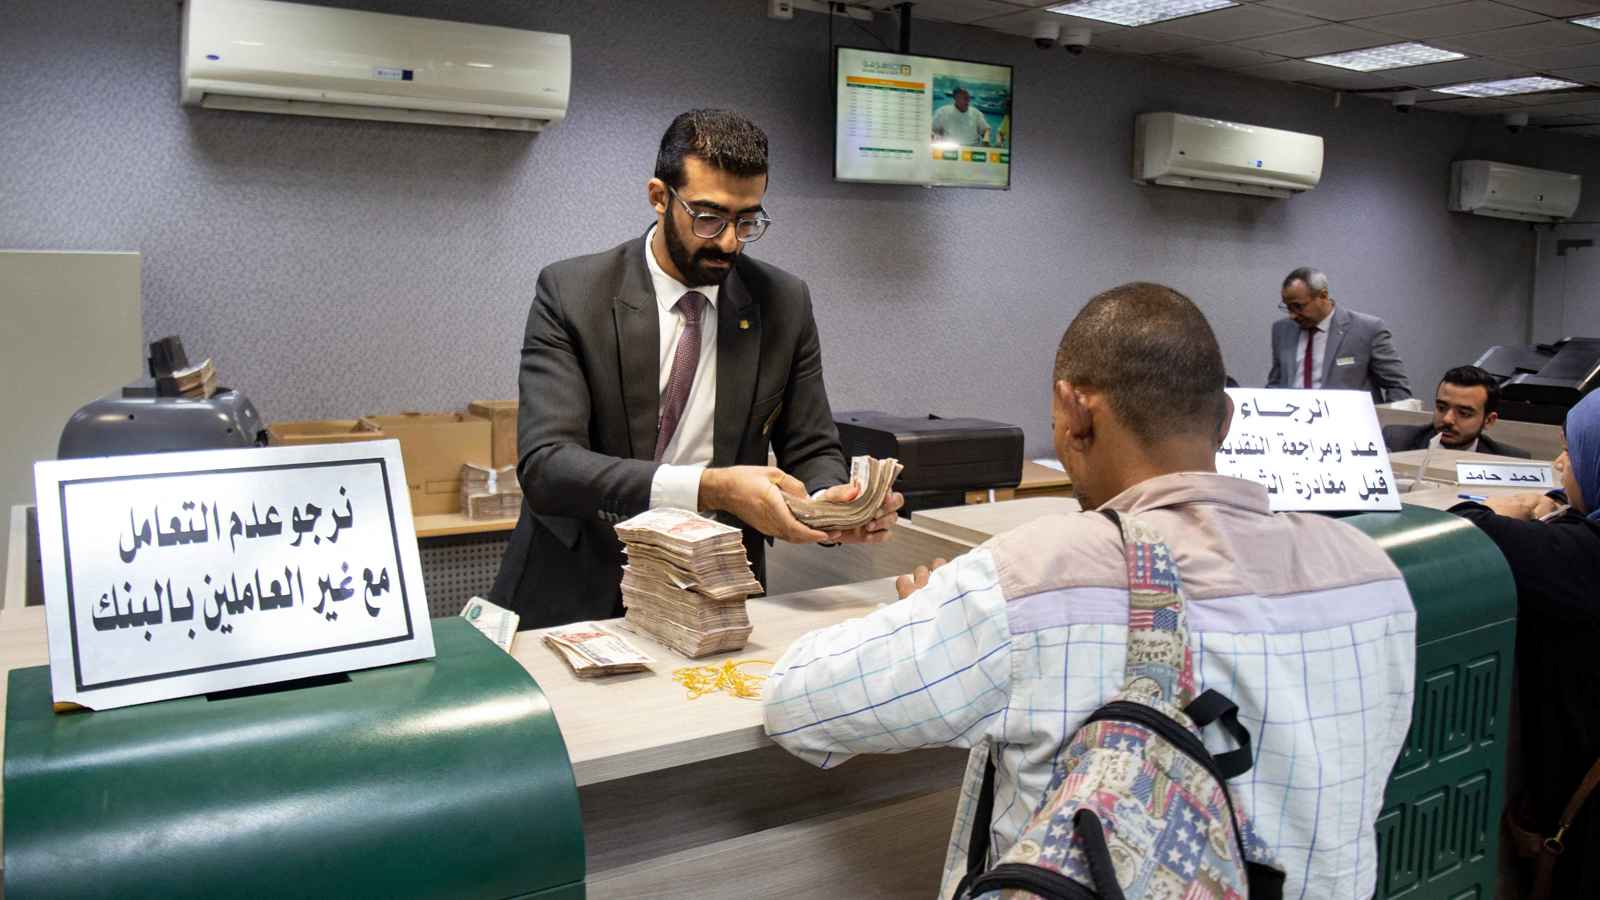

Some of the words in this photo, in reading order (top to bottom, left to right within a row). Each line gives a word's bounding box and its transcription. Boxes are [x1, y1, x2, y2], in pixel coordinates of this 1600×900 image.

[1240, 397, 1330, 425] الرجاء
[1277, 431, 1343, 463] ومراجعة
[1351, 439, 1379, 457] عد
[1295, 471, 1347, 501] مغادرة
[1358, 468, 1390, 502] قبل
[119, 501, 221, 565] التعامل
[229, 501, 283, 553] عدم
[289, 485, 353, 548] نرجو
[91, 572, 197, 643] بالبنك
[203, 564, 304, 635] العاملين
[312, 561, 356, 622] غير
[362, 563, 391, 619] مع
